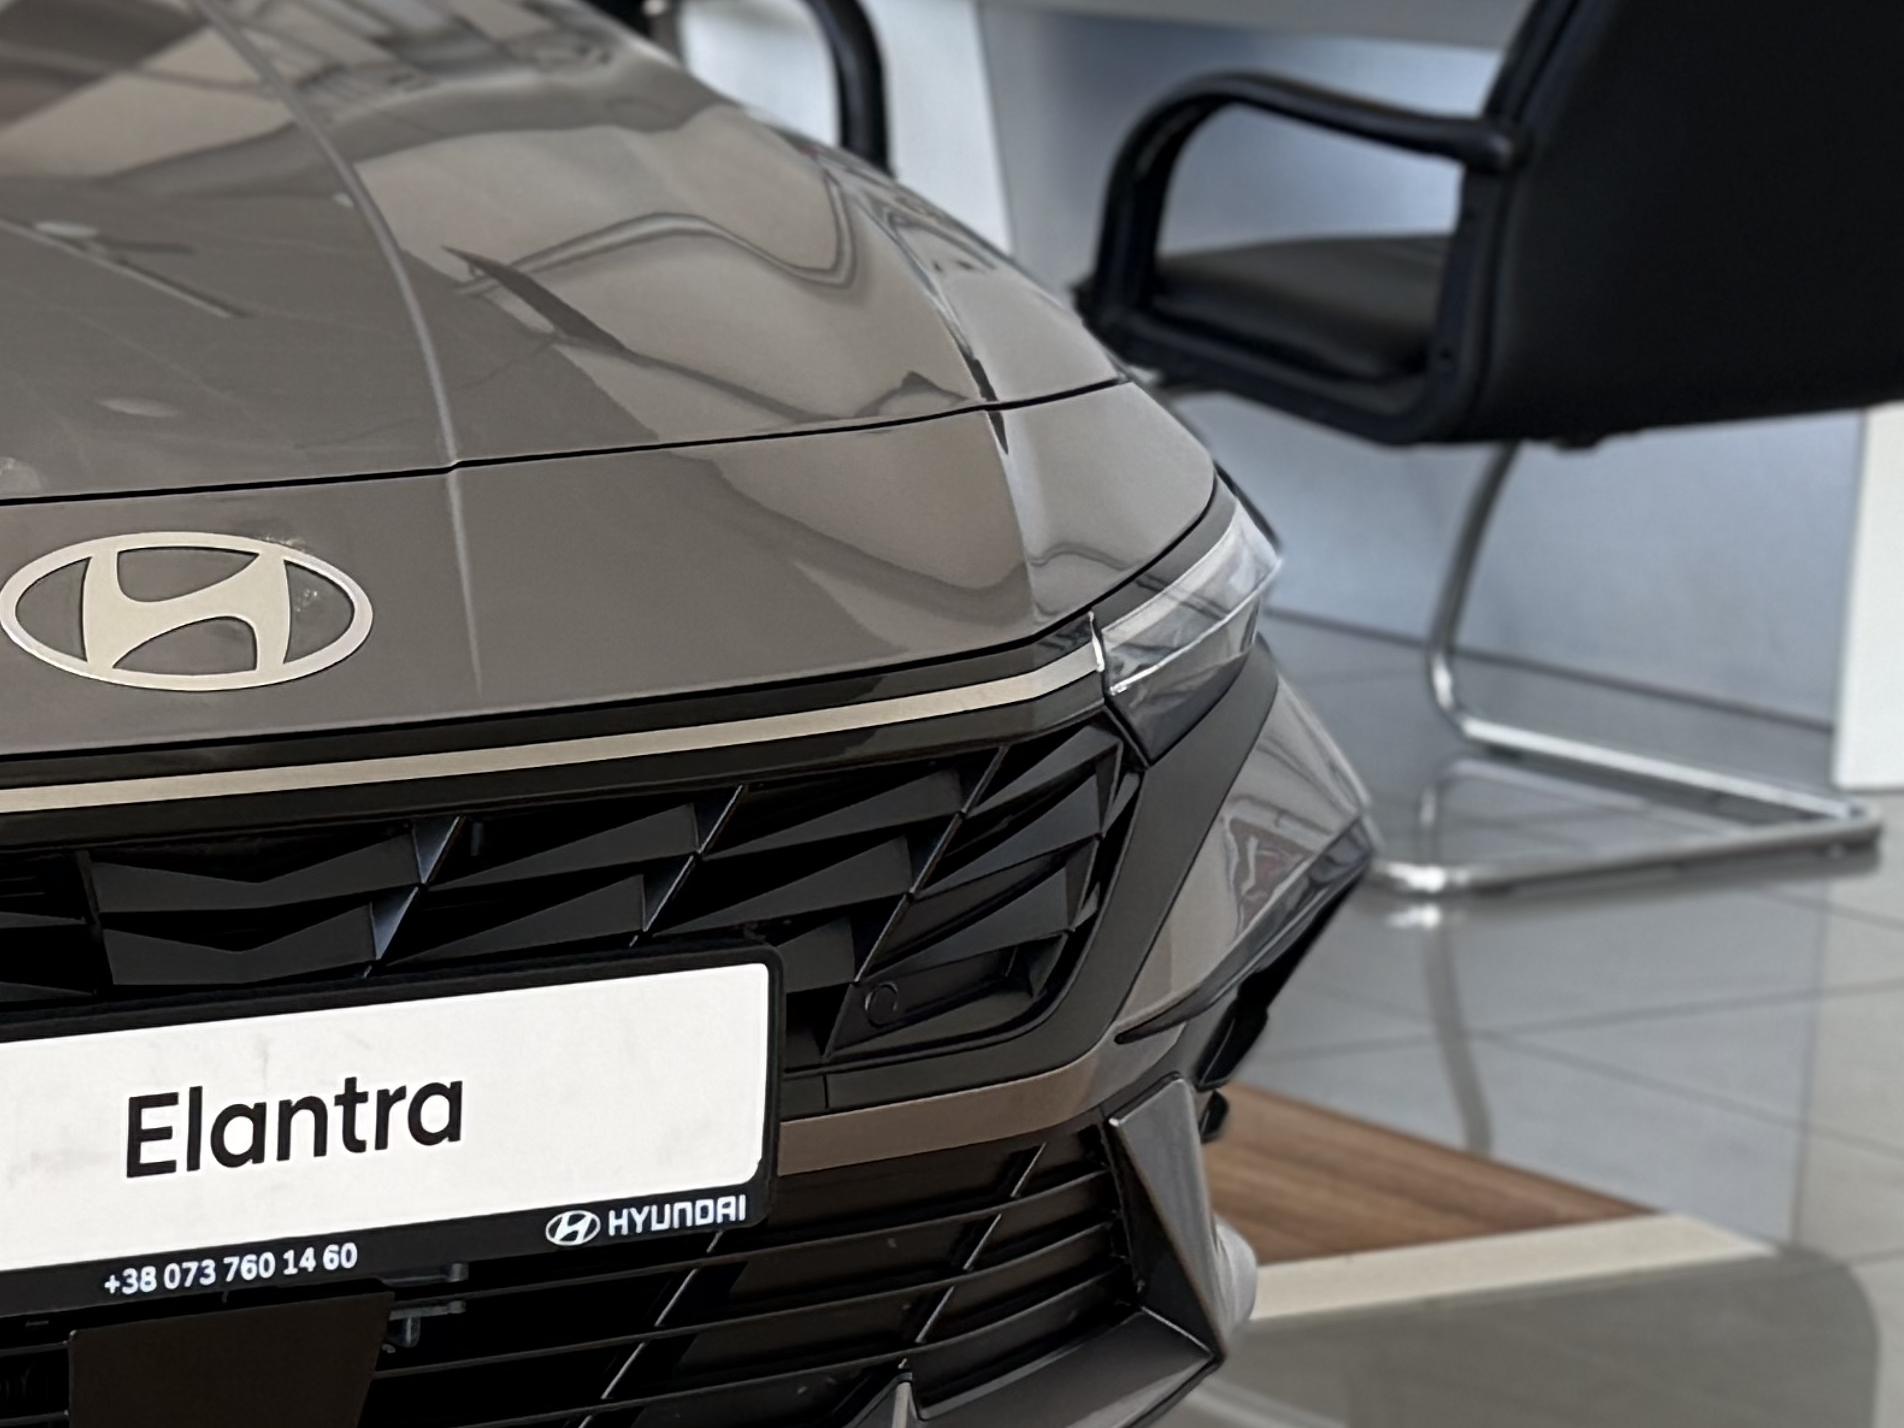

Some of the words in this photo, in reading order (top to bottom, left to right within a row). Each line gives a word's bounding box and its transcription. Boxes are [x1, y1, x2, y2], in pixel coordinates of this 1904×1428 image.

[126, 1076, 463, 1178] Elantra
[608, 1193, 747, 1237] HYUNDAI
[103, 1265, 158, 1295] +38
[163, 1258, 217, 1290] 073
[222, 1251, 277, 1283] 760
[282, 1246, 317, 1275] 14
[322, 1241, 359, 1270] 60
